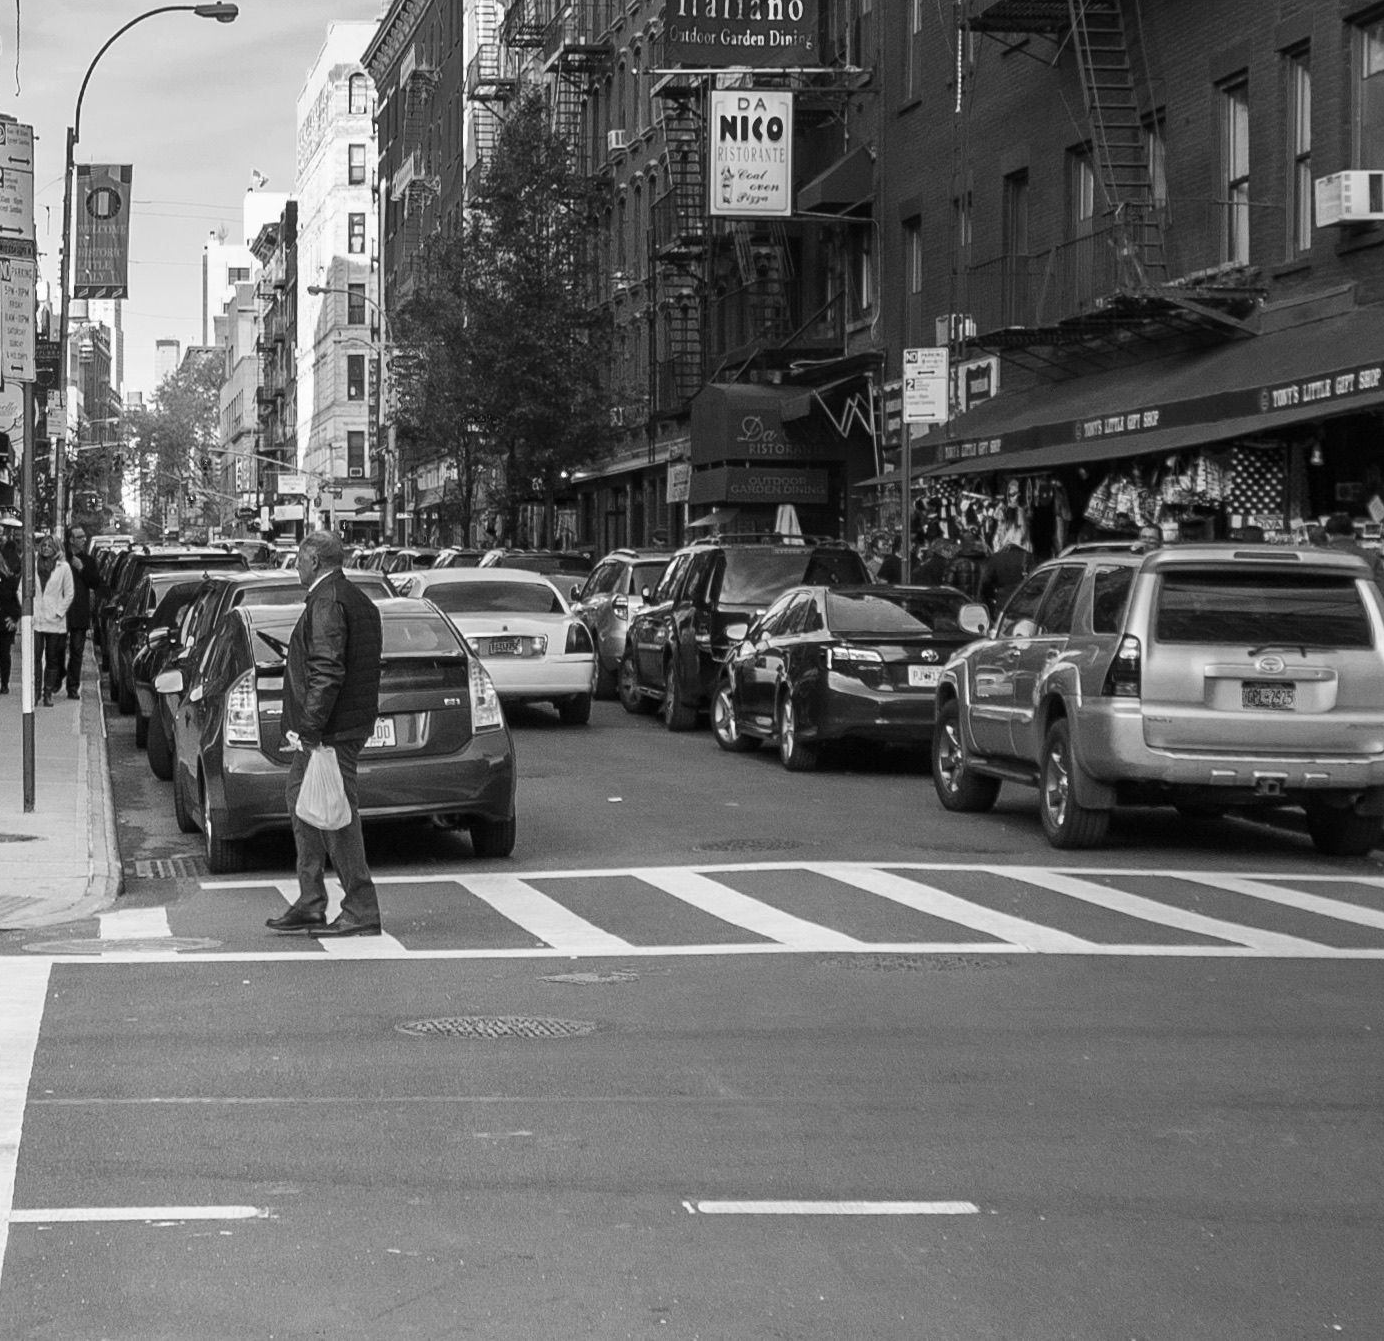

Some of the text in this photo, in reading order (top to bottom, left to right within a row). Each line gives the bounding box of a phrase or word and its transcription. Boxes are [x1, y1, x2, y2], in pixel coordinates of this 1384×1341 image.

[669, 28, 814, 50] Outdoor Garden Dining
[737, 97, 767, 111] DA
[720, 115, 784, 143] NICO
[718, 146, 785, 163] RISTORANTE
[906, 379, 915, 391] 2
[1272, 368, 1382, 408] TONY'S LITTLE GIFT SHOP
[737, 416, 777, 441] Da
